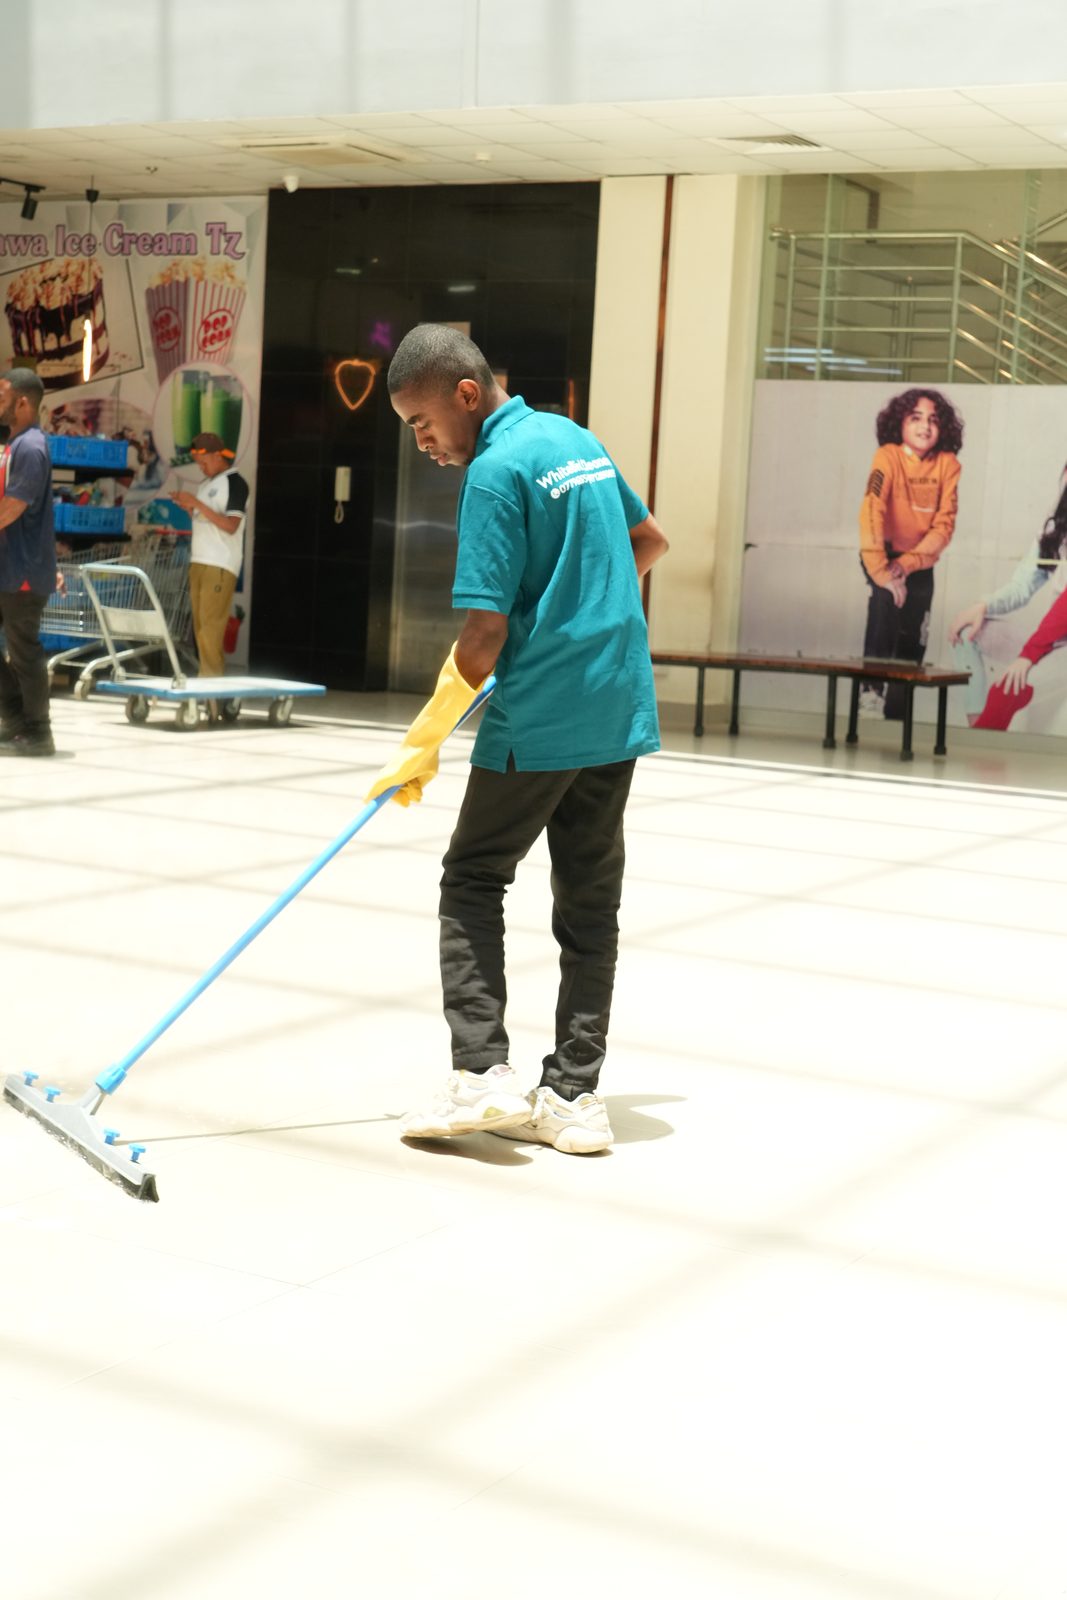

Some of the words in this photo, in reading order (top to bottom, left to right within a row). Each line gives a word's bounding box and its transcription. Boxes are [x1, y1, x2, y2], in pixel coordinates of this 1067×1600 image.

[55, 224, 97, 257] Ice
[103, 223, 198, 257] Cream
[205, 222, 246, 260] Tz
